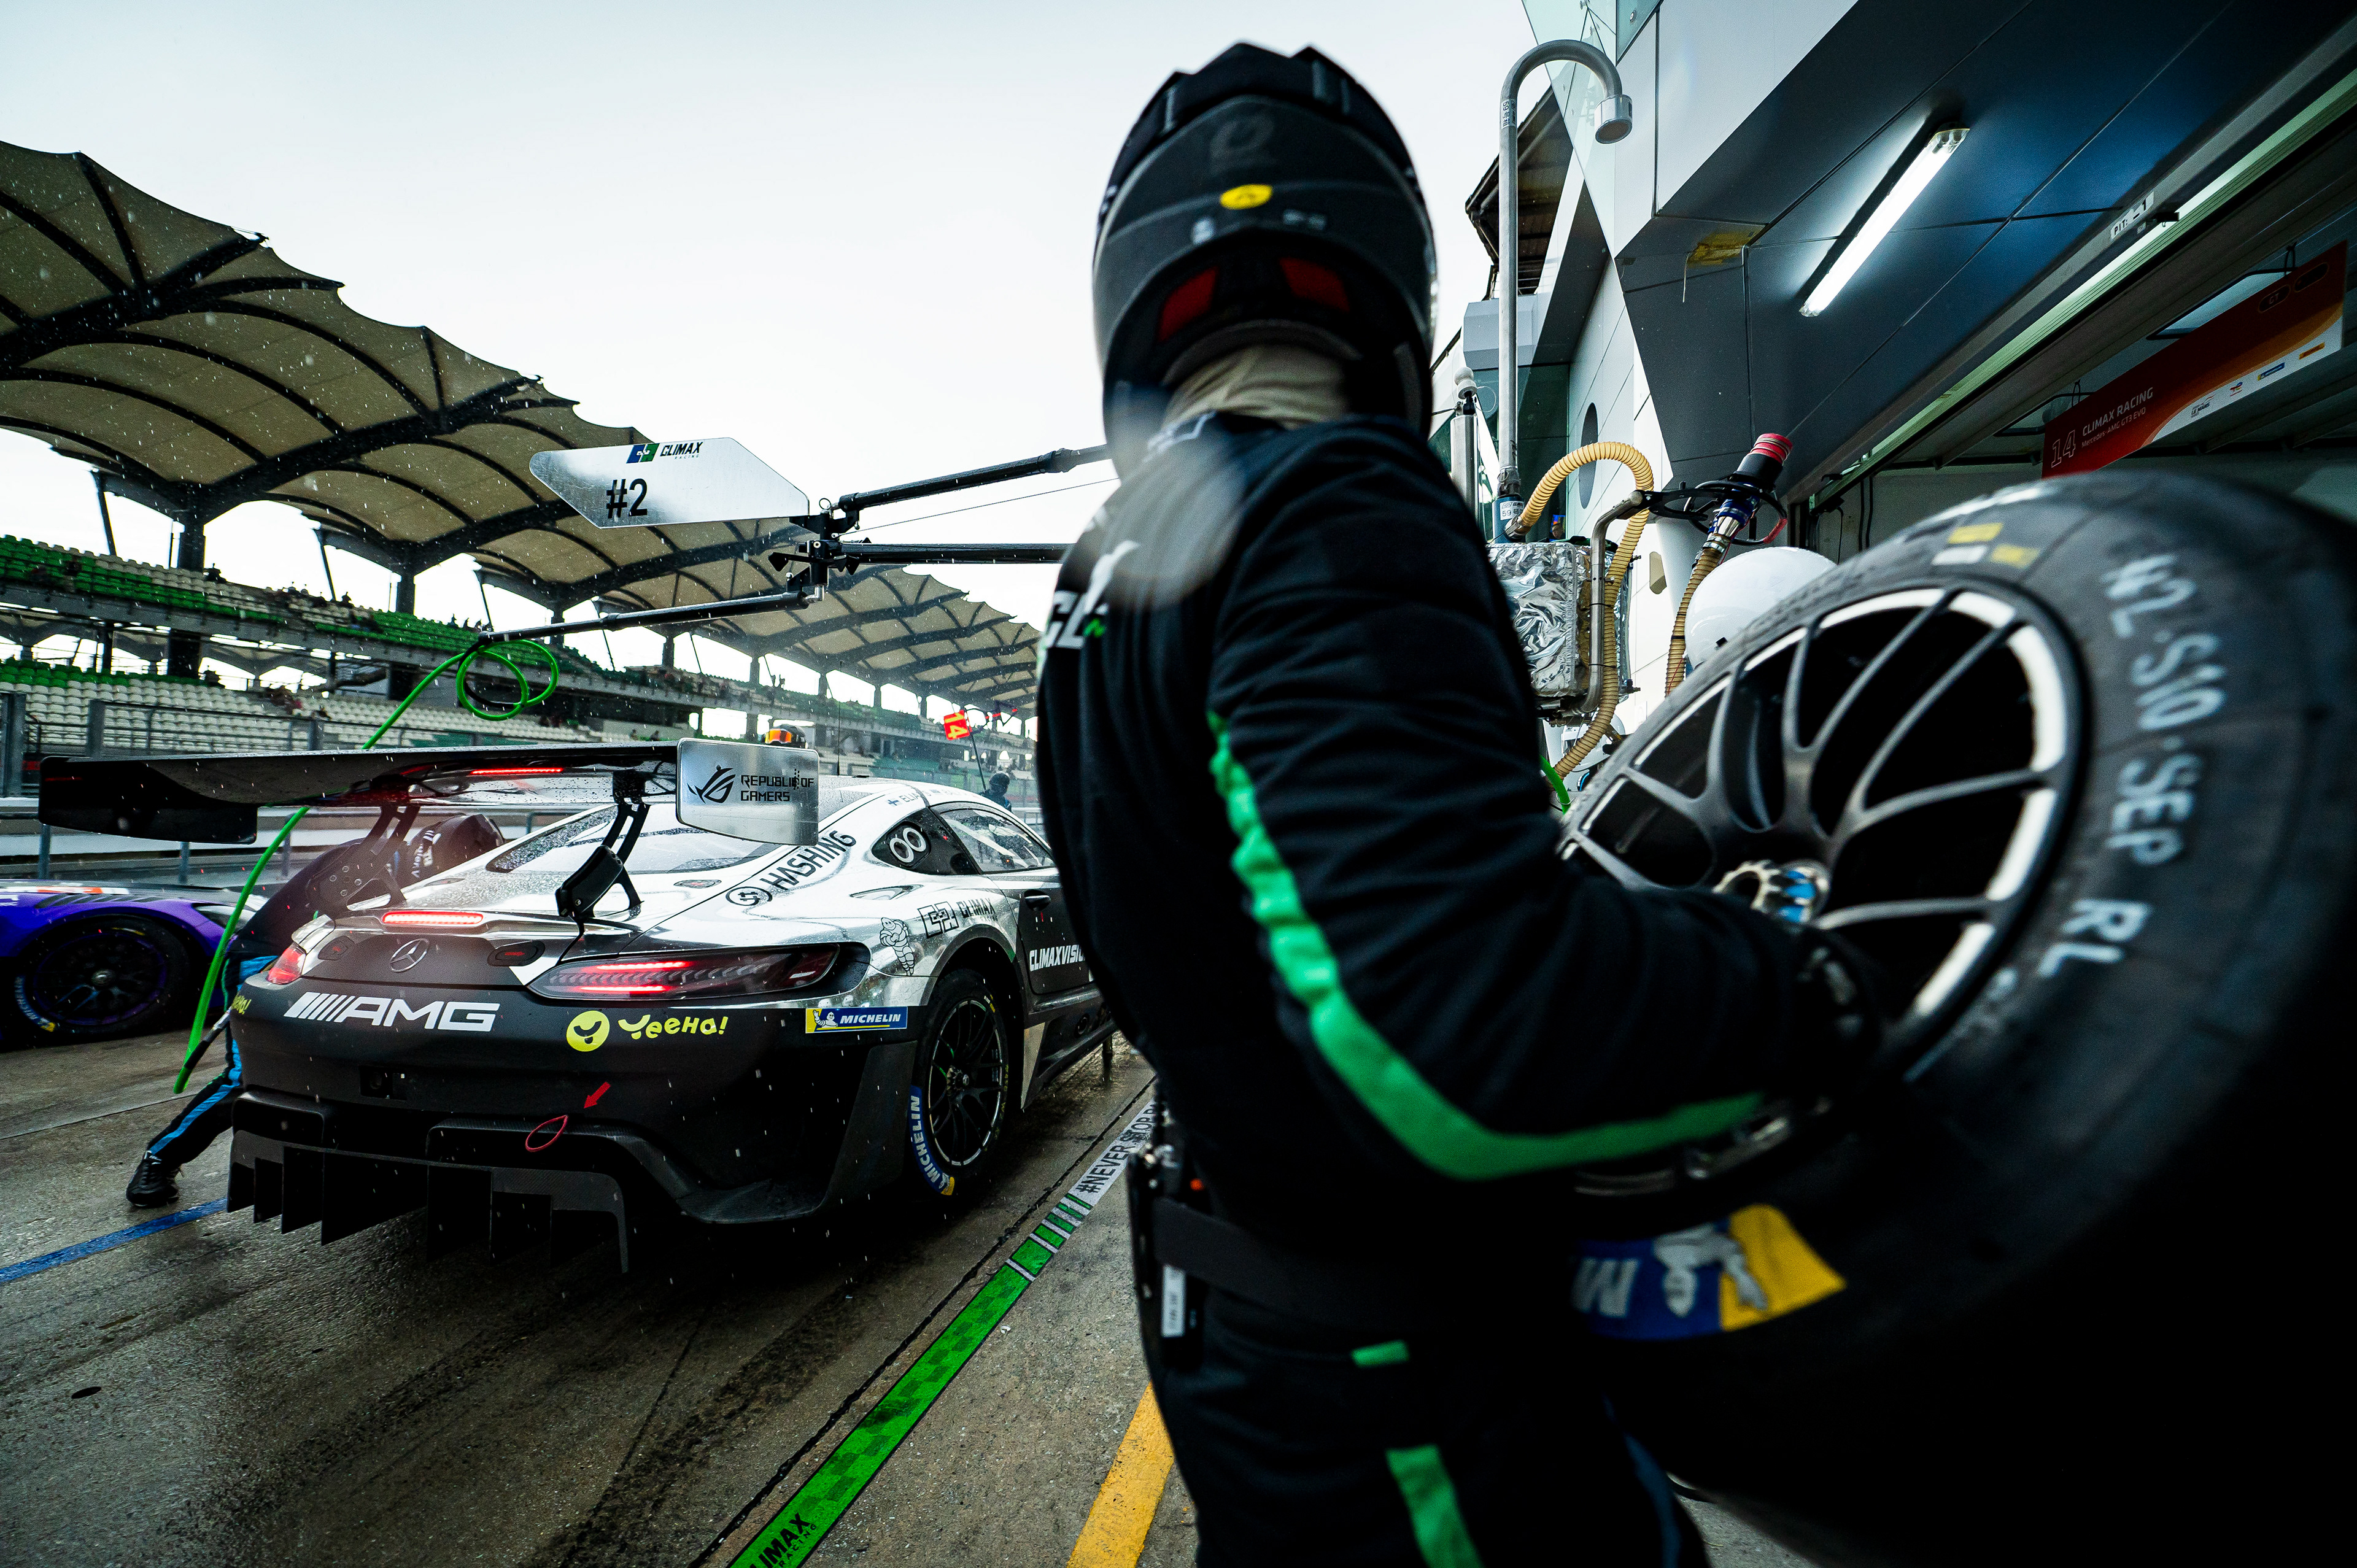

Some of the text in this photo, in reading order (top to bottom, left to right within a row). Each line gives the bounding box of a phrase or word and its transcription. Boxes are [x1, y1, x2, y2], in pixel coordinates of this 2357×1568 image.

[2081, 407, 2146, 448] Mercedes-AMG GT3 EVO
[2083, 387, 2153, 436] CLIMAX RACING
[660, 442, 703, 457] CLIMAX
[2051, 430, 2076, 468] 14
[606, 478, 648, 519] #2
[945, 713, 968, 739] 14
[741, 790, 791, 801] GAMERS
[801, 778, 815, 787] OF
[760, 830, 856, 890] HASHING
[956, 898, 996, 918] CLIMAX
[334, 996, 500, 1032] AMG
[840, 1014, 901, 1024] MICHELIN
[910, 1095, 942, 1183] MICHELIN
[1075, 1145, 1136, 1194] #NEVER
[778, 1523, 817, 1568] RACING
